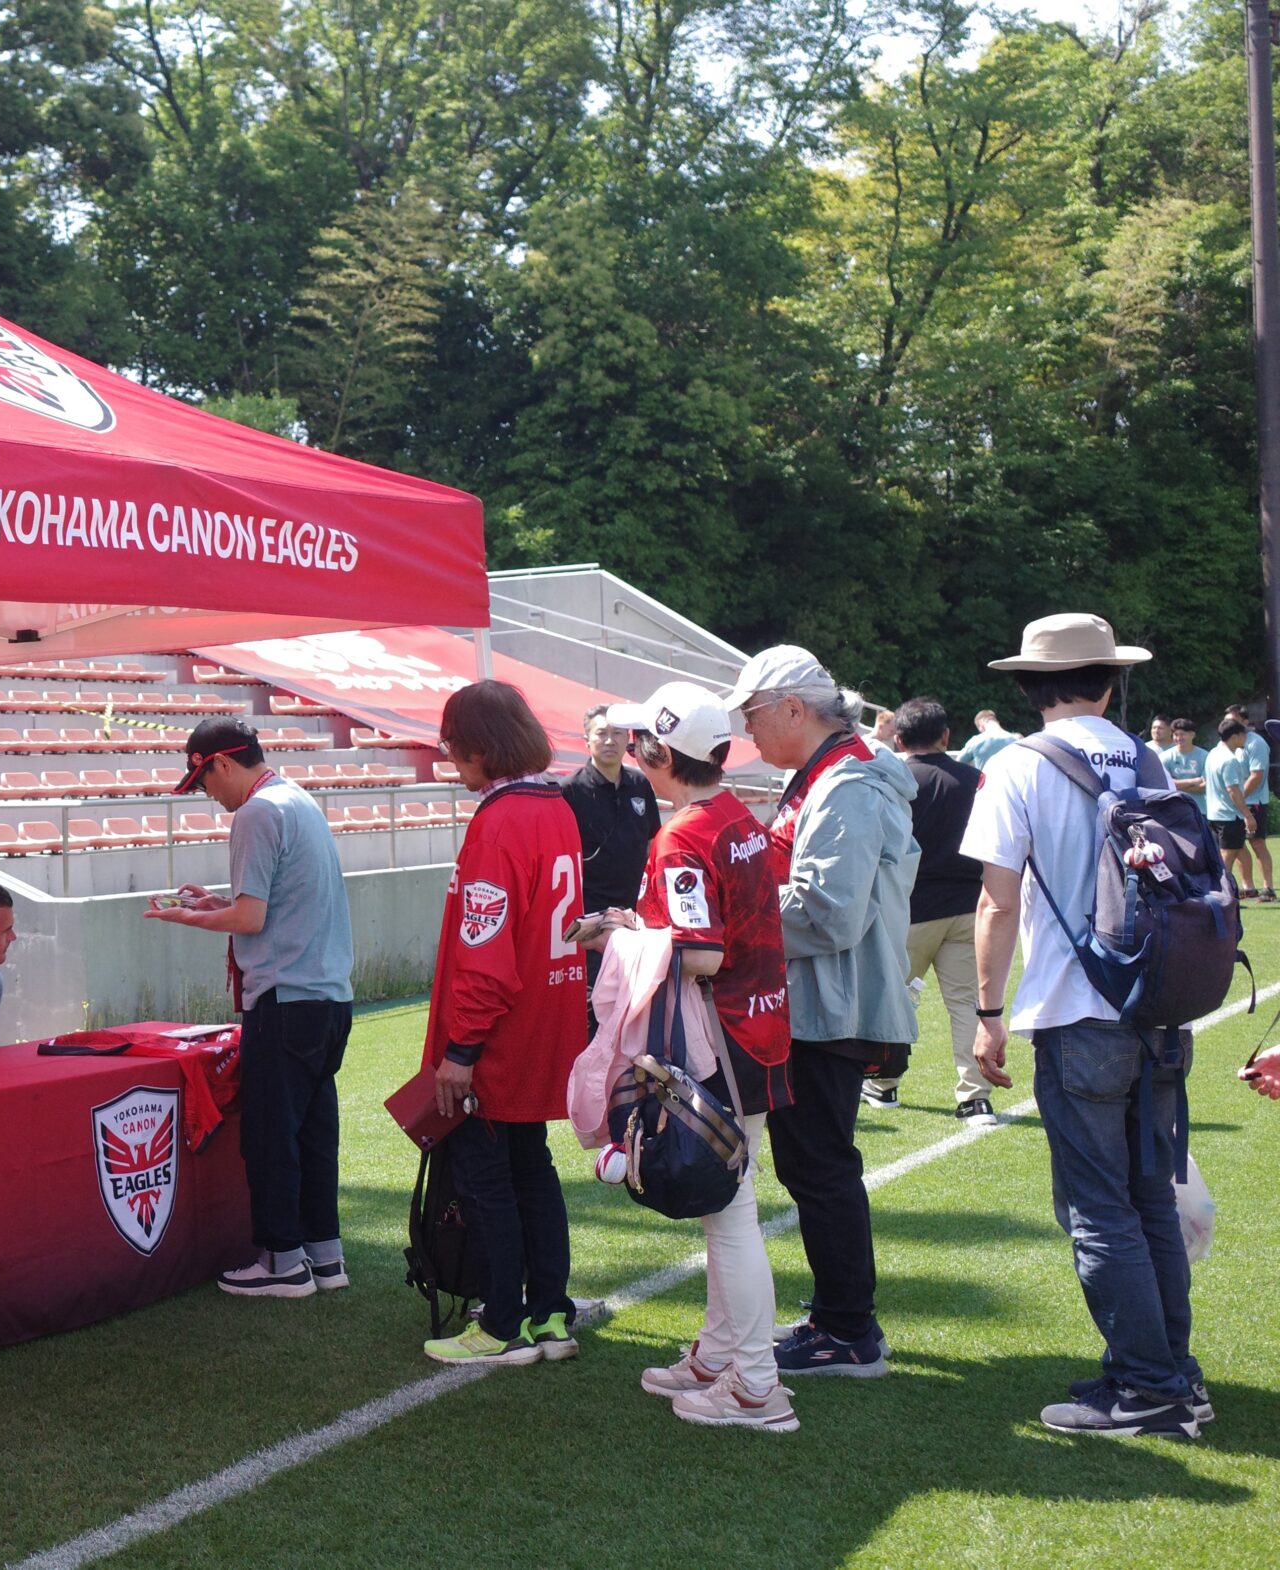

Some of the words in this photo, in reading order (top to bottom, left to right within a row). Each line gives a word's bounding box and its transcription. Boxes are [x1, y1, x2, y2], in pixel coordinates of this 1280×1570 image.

[147, 502, 255, 561] CANON
[260, 517, 359, 572] EAGLES
[550, 851, 584, 960] 2
[681, 901, 696, 912] ONE
[464, 912, 499, 926] AGLES
[113, 1103, 163, 1124] YOKOHAMA
[122, 1117, 156, 1135] CANON
[109, 1162, 172, 1200] EAGLES
